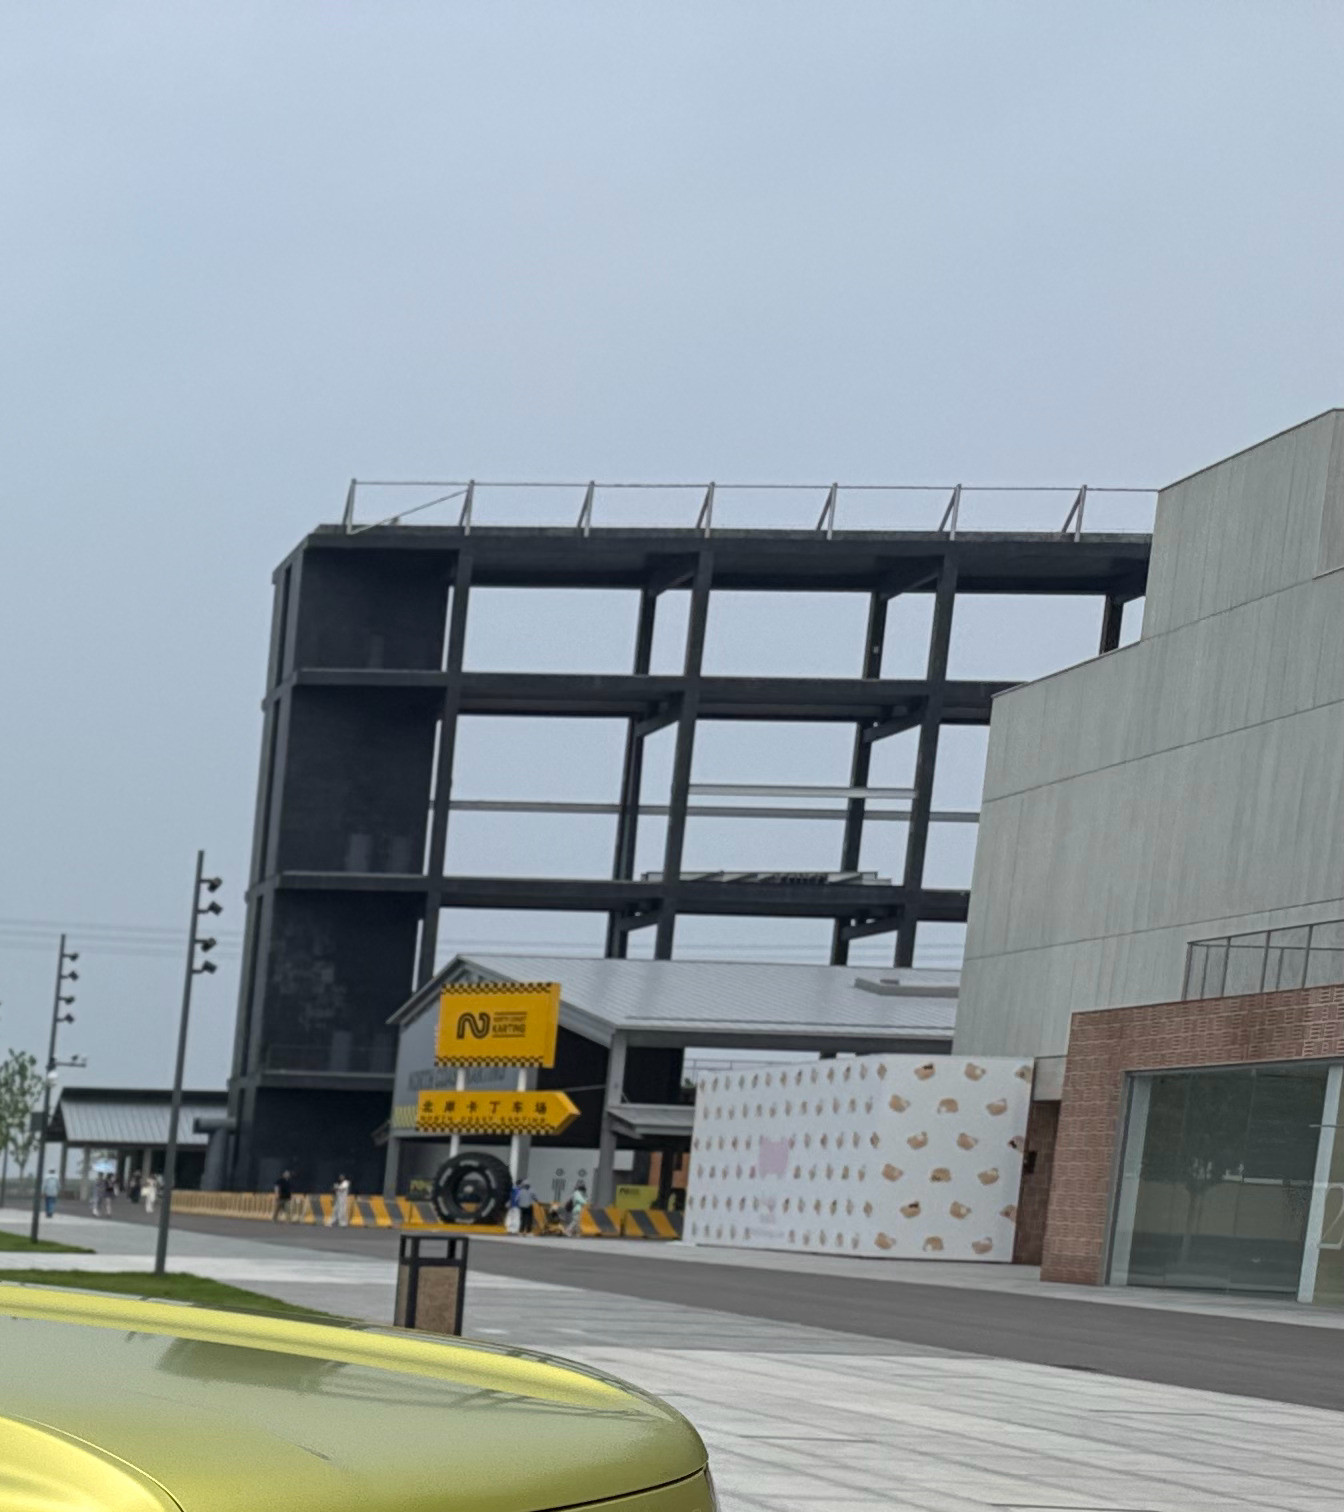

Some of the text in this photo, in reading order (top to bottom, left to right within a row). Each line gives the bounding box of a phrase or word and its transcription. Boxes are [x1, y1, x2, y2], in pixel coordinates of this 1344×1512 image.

[422, 1100, 548, 1115] 北岸卡丁车场
